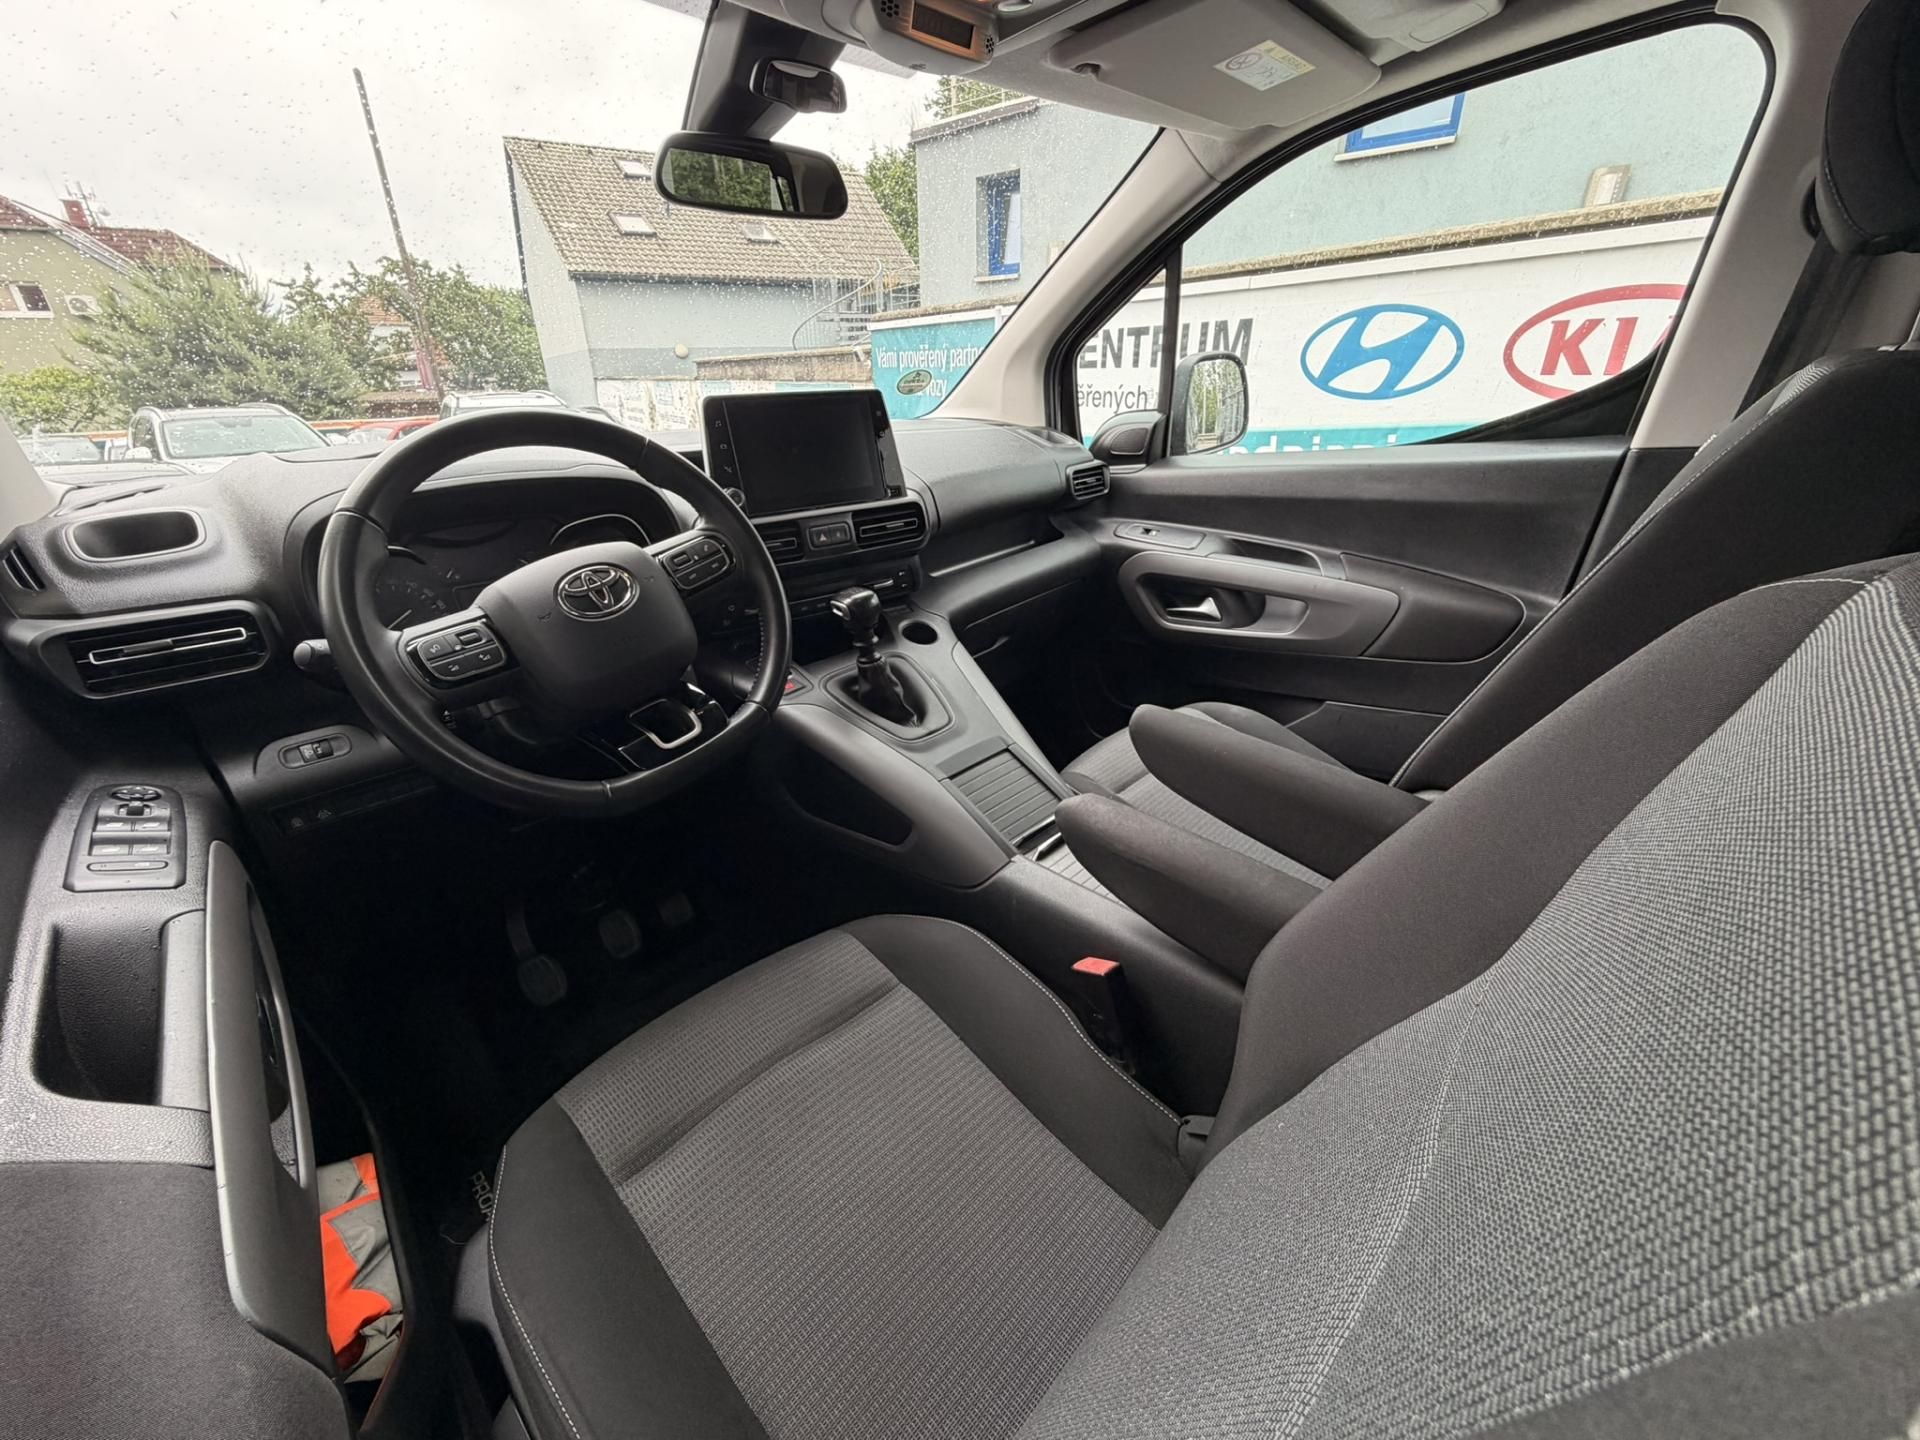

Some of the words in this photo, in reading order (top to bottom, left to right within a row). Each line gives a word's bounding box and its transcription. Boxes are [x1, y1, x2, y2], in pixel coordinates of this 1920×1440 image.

[875, 346, 897, 369] Vámi
[899, 343, 947, 373] prověřený
[1540, 316, 1672, 376] KI
